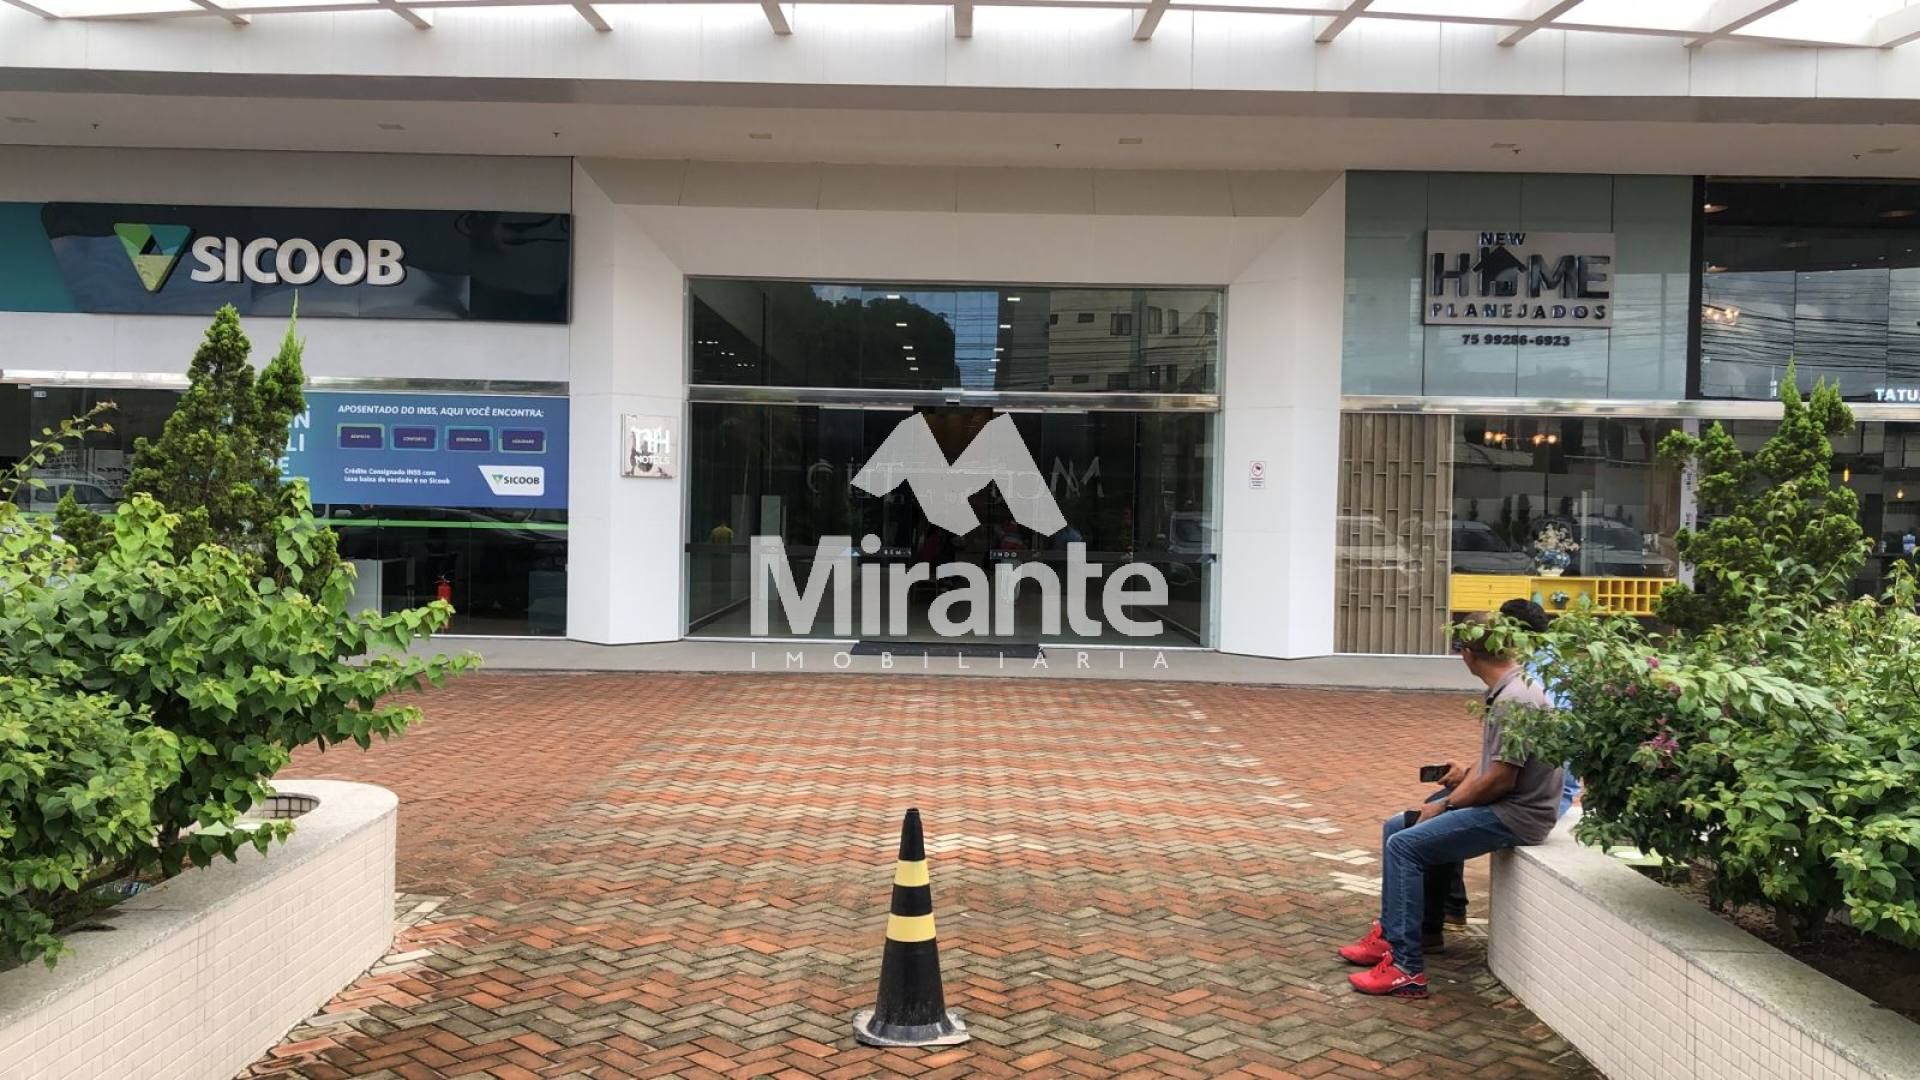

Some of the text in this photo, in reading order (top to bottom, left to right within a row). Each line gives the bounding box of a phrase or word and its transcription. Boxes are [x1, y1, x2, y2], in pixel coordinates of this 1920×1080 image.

[1479, 232, 1526, 247] NEW
[190, 236, 405, 286] SICOOB
[1432, 303, 1607, 320] PLANEJADOS
[1462, 334, 1571, 347] 75 99286-6923
[1874, 388, 1920, 402] TATU
[338, 405, 544, 417] APOSENTADO DO INSS, AQUI VOCÊ ENCONTRA:
[343, 467, 367, 475] Crédito
[368, 468, 405, 476] Consignado
[406, 468, 421, 476] INSS
[503, 476, 540, 485] SICOOB
